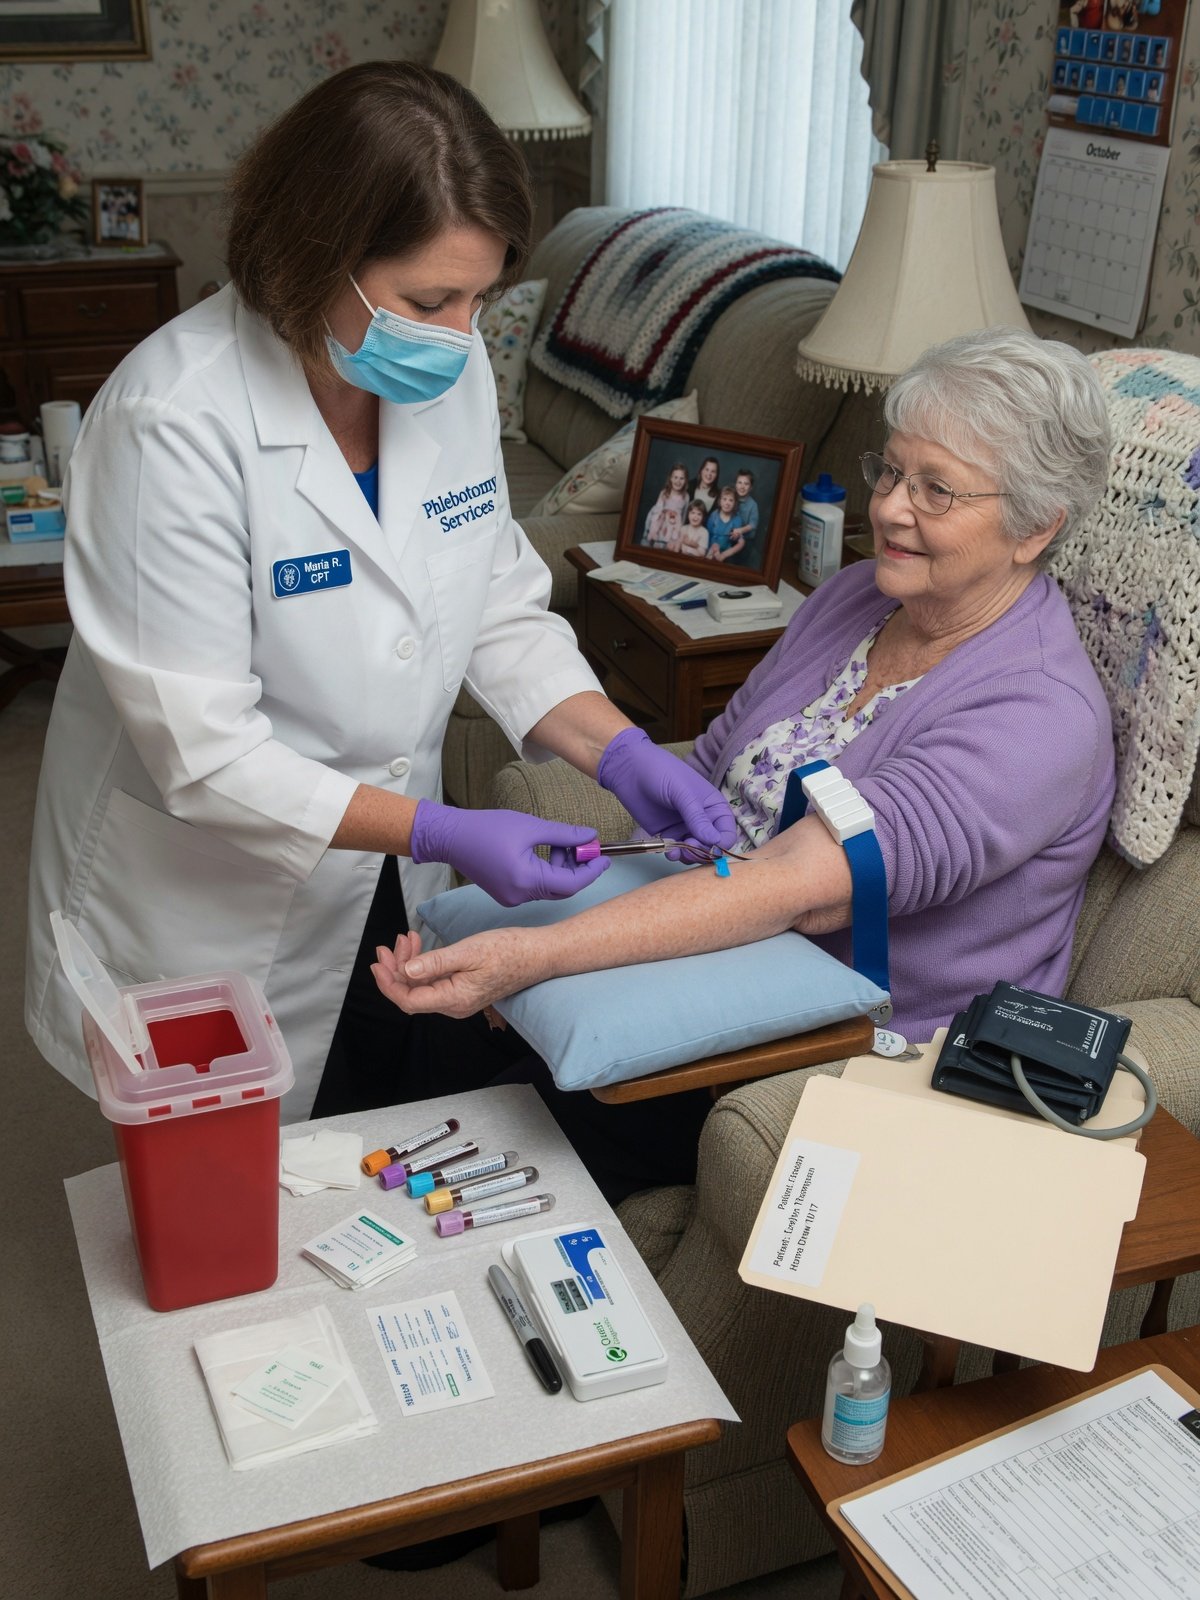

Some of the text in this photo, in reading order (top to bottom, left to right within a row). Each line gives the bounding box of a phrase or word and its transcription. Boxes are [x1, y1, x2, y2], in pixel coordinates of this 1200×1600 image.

[1086, 142, 1121, 160] October
[422, 475, 498, 519] Phlebotomy
[440, 500, 495, 533] Services
[304, 557, 342, 573] Maria R.
[311, 571, 330, 584] CPT
